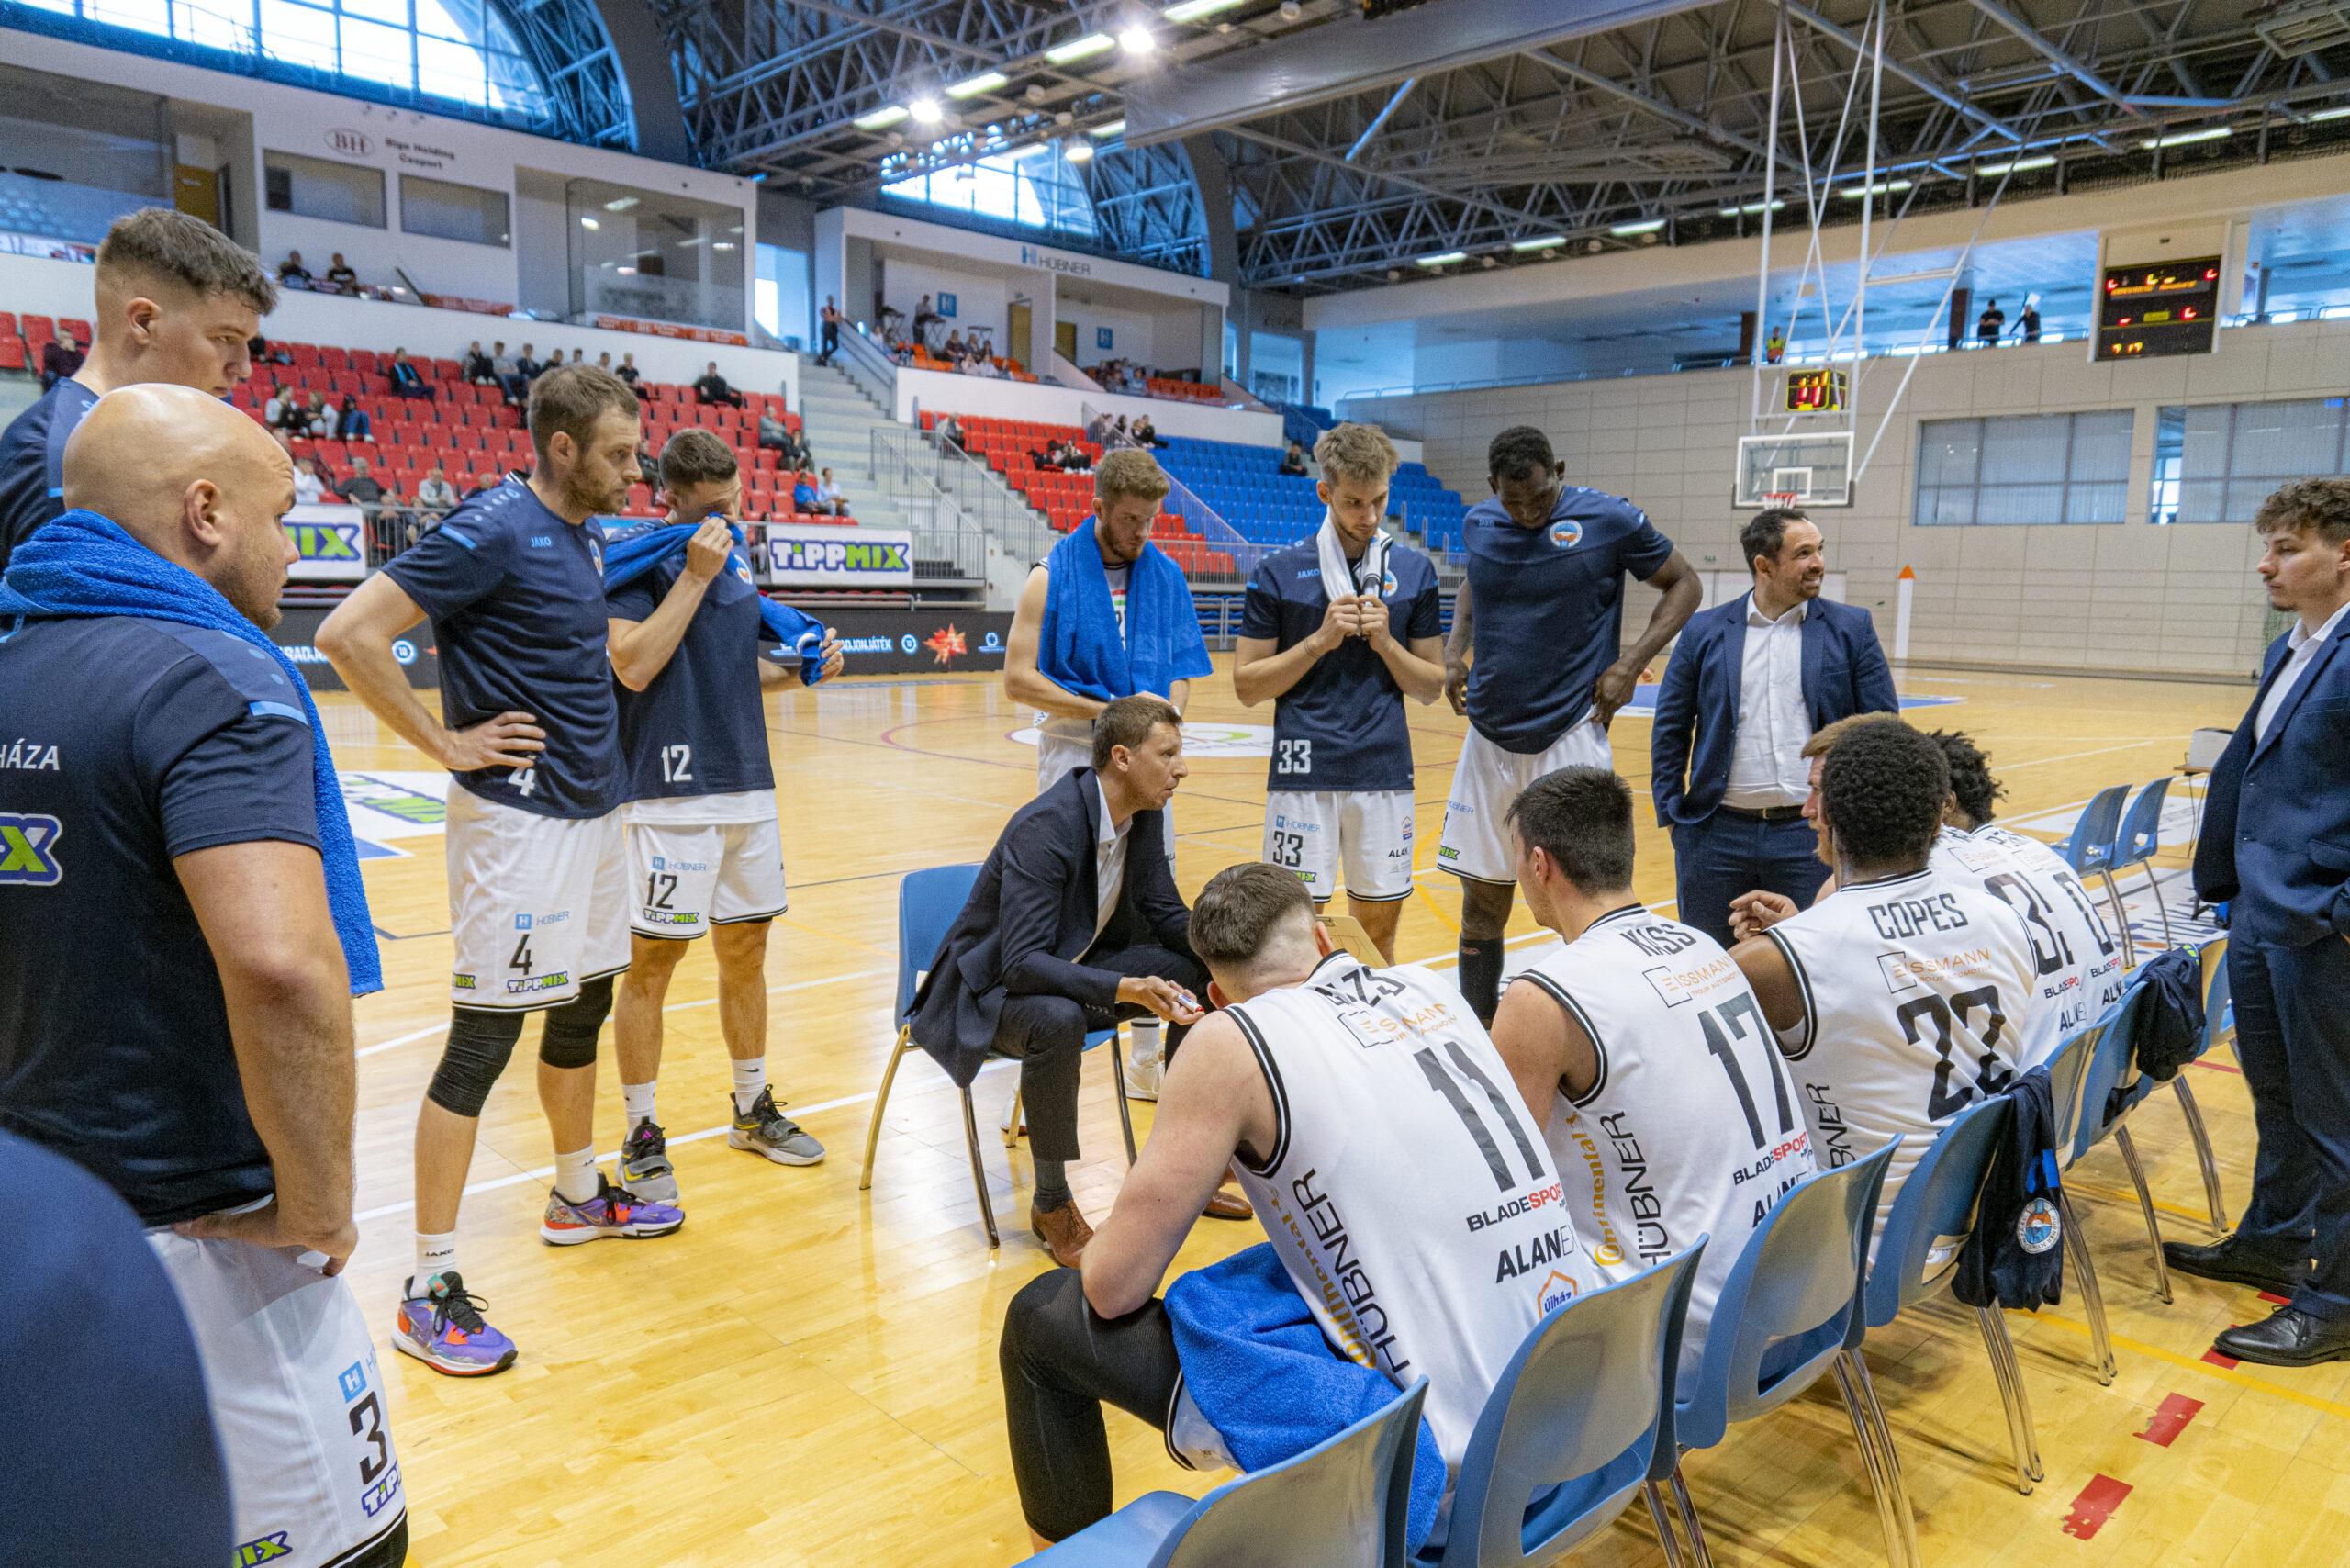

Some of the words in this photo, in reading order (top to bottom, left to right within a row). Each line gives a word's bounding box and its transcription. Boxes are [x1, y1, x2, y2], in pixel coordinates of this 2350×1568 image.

[531, 536, 552, 548] JAKO
[1296, 568, 1322, 579] JAKO
[507, 755, 537, 797] 4
[661, 745, 692, 783] 12
[1278, 739, 1312, 774] 33
[1272, 830, 1304, 868] 33
[646, 872, 677, 910] 12
[1867, 891, 1969, 941] COPES
[509, 933, 532, 976] 4
[1697, 991, 1795, 1151] 17
[1897, 984, 2016, 1123] 22
[1413, 1041, 1546, 1193] 11
[1599, 1111, 1672, 1266] HÜBNER
[425, 1248, 454, 1257] JAKO
[1292, 1167, 1412, 1374] HÜBNER
[349, 1390, 388, 1485] 3
